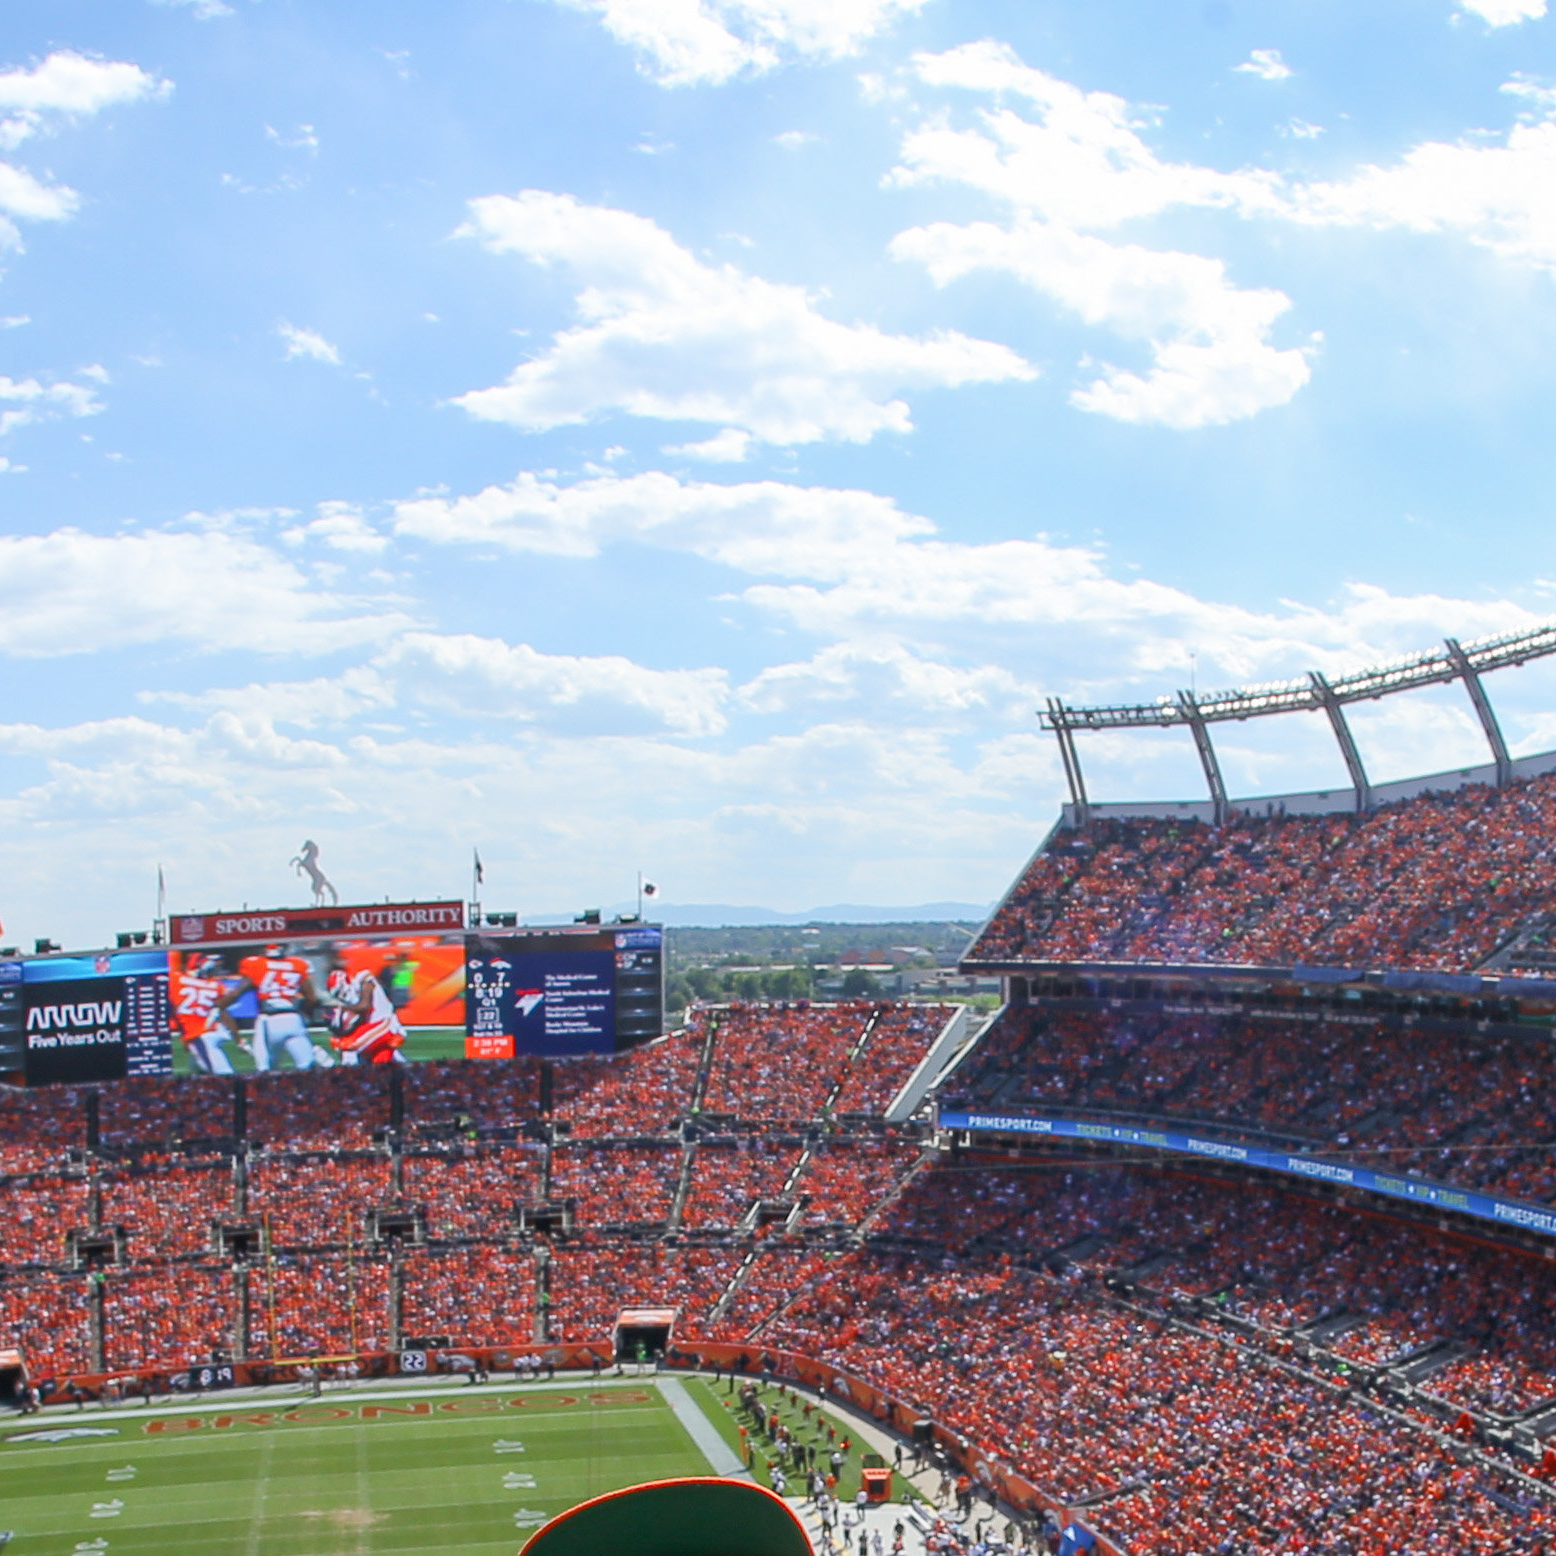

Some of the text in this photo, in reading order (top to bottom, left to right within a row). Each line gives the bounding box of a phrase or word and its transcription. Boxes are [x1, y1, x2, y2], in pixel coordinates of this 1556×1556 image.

[216, 907, 461, 935] SPORTS AUTHORITY
[474, 972, 505, 984] 0 7
[27, 1001, 122, 1030] ARROW
[28, 1029, 122, 1050] Five Years Out
[969, 1116, 1052, 1133] PRIMESPORT.COM
[1188, 1139, 1247, 1159] PRIMESPORT.COM
[1288, 1158, 1354, 1182] PRIMESPORT.COM
[403, 1352, 424, 1370] 22
[143, 1390, 653, 1435] BRONCOS
